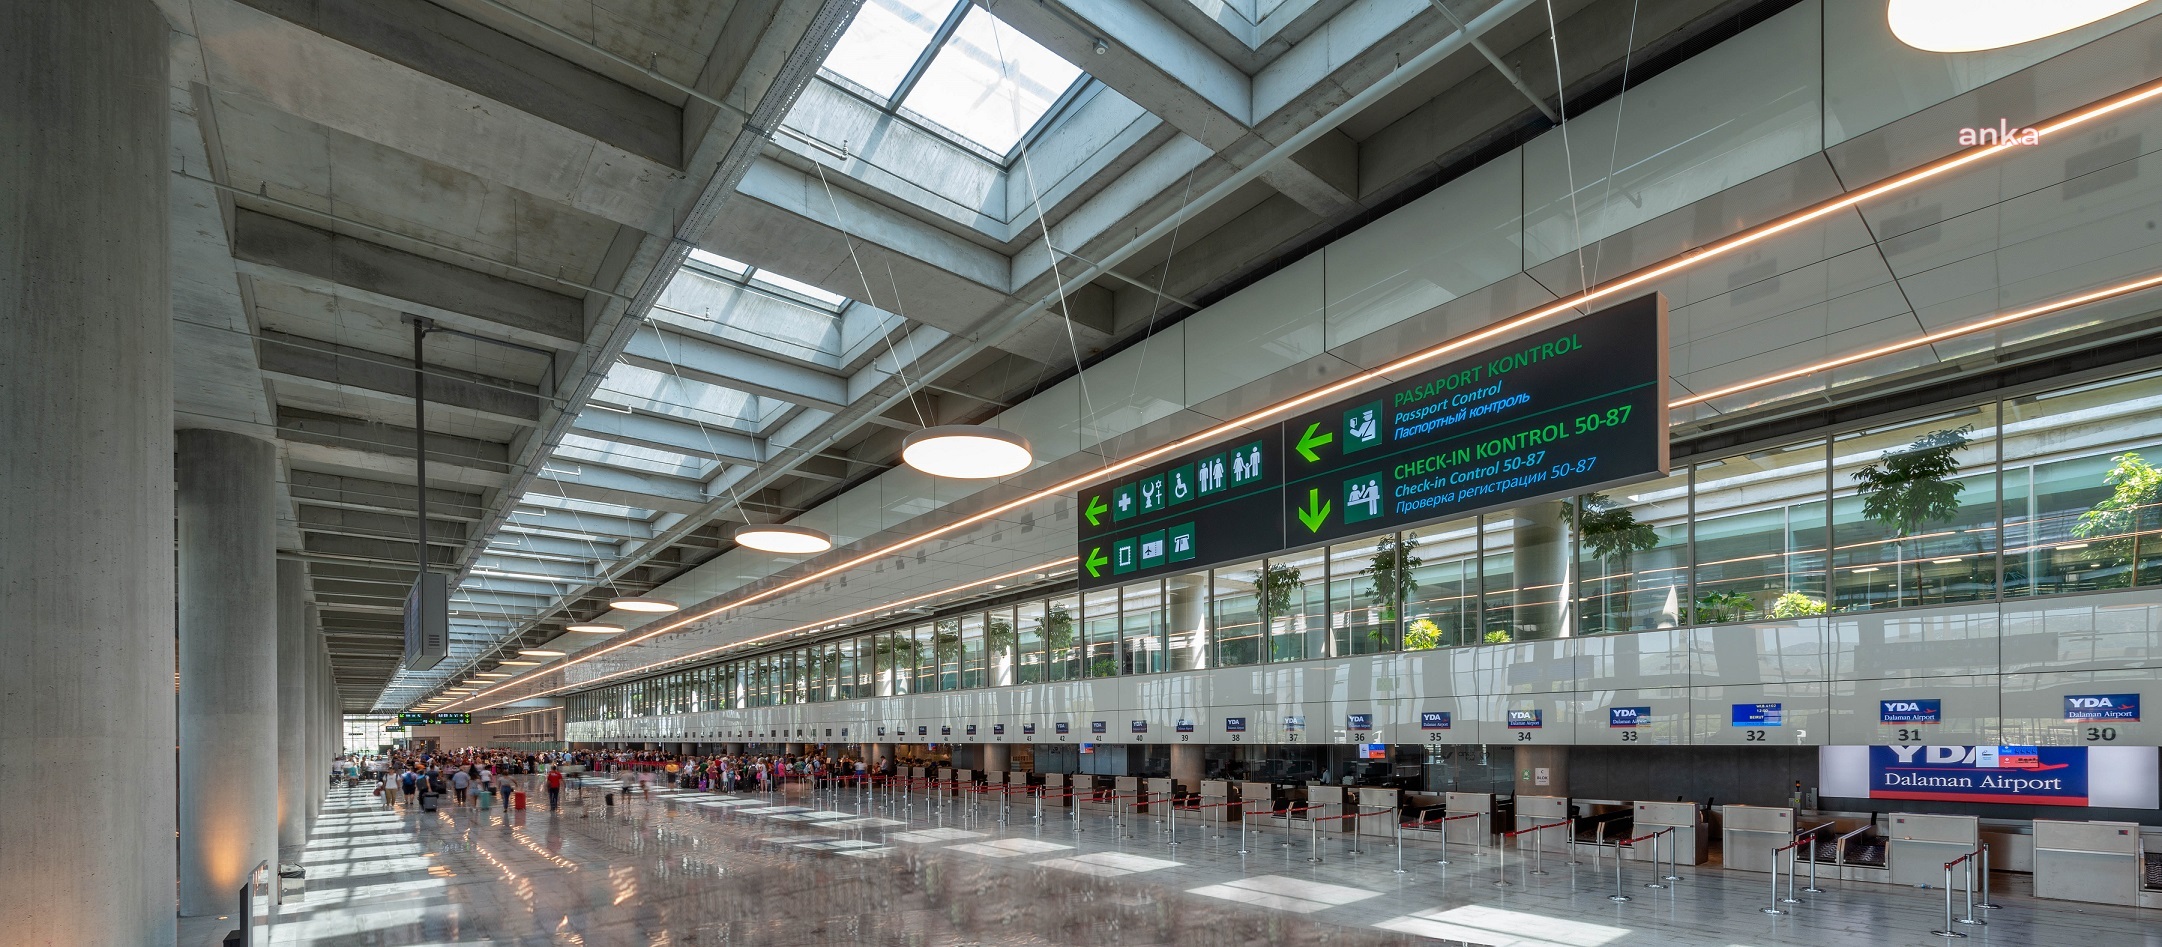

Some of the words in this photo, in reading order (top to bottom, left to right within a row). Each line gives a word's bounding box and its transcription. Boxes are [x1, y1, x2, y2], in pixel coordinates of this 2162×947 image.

[1395, 366, 1482, 408] PASAPORT
[1488, 334, 1582, 377] KONTROL
[1395, 399, 1448, 425] Passport
[1452, 380, 1503, 407] Control
[1395, 408, 1466, 440] Паспортный
[1469, 392, 1531, 417] контроль
[1394, 447, 1471, 480] CHECK-IN
[1477, 422, 1569, 460] KONTROL
[1575, 405, 1632, 435] 50-87
[1395, 475, 1446, 498] Check-in
[1450, 461, 1499, 485] Control
[1503, 450, 1546, 472] 50-87
[1396, 491, 1455, 514] Проверка
[1458, 471, 1547, 502] регистрации
[1550, 456, 1597, 480] 50-87
[1884, 702, 1919, 712] YDA
[2069, 697, 2114, 708] YDA
[1613, 709, 1637, 717] YDA
[2104, 711, 2133, 719] Airport
[1136, 734, 1144, 742] 40
[1181, 734, 1189, 742] 39
[1231, 734, 1240, 742] 38
[1289, 733, 1299, 742] 37
[1354, 733, 1365, 742] 36
[1430, 732, 1442, 741] 35
[1518, 732, 1532, 741] 34
[1622, 731, 1638, 741] 33
[1746, 730, 1766, 741] 32
[1898, 729, 1921, 741] 31
[2086, 727, 2116, 741] 30
[1889, 745, 1976, 764] YD
[1884, 773, 1972, 788] Dalaman
[1979, 775, 2061, 793] Airport
